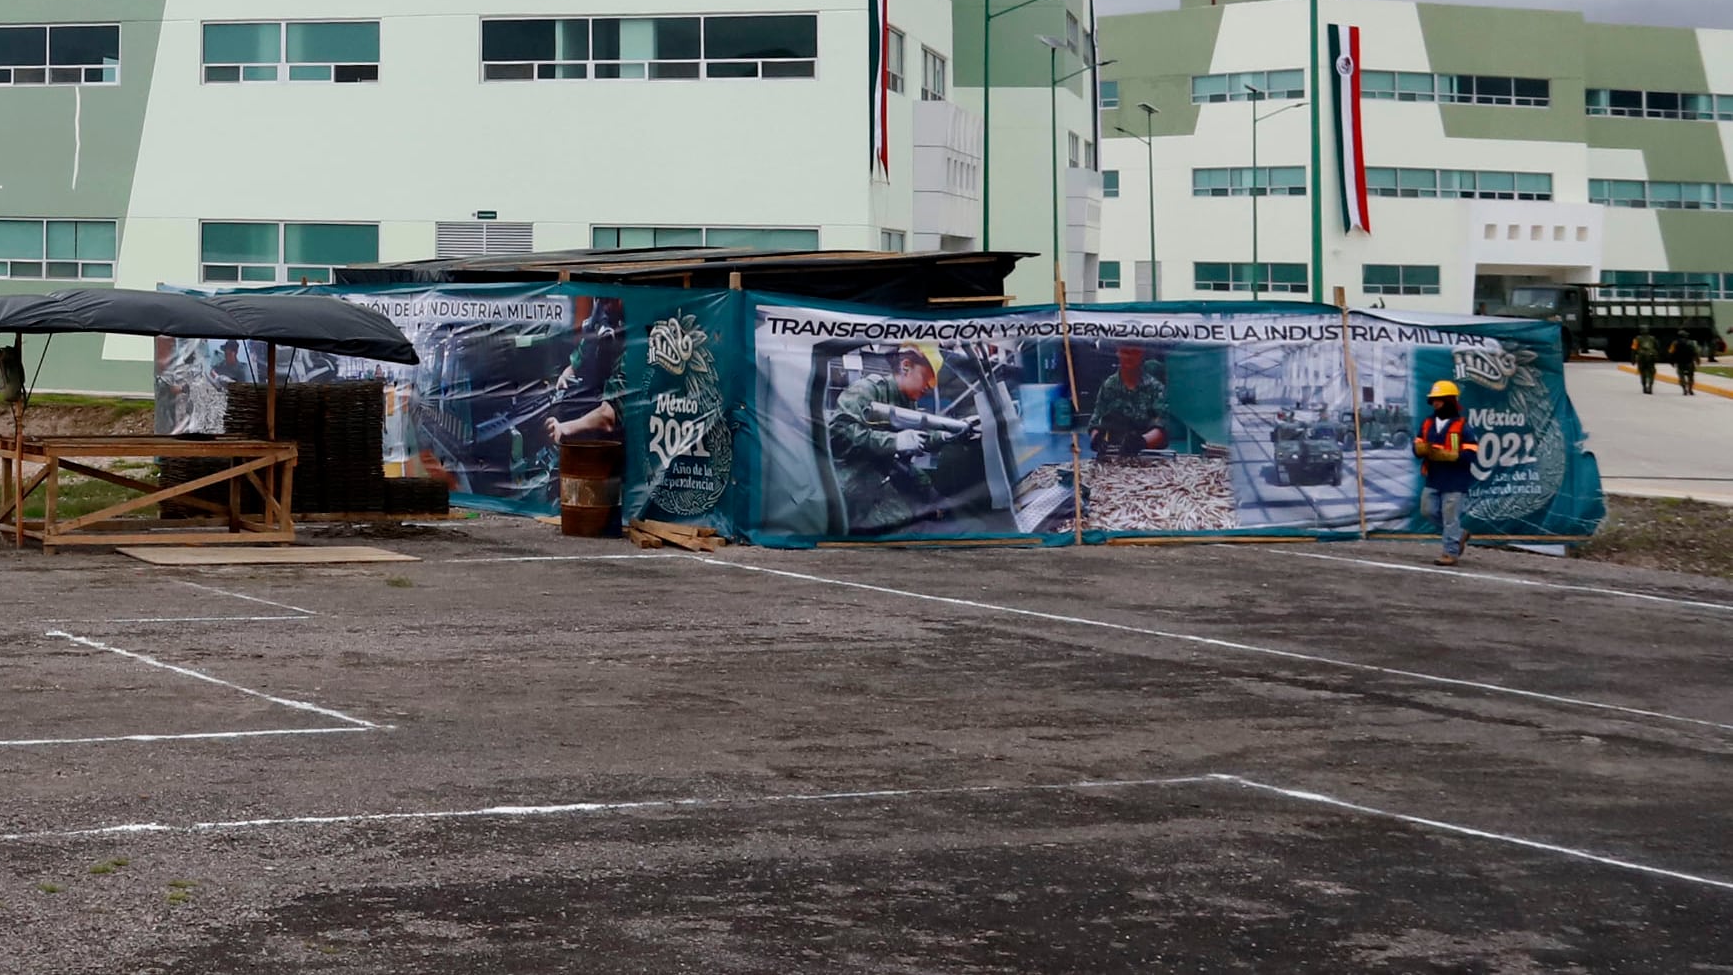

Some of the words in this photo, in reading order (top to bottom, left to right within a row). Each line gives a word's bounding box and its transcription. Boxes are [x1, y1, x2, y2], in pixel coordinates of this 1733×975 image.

[394, 302, 409, 316] DE
[412, 300, 425, 316] LA
[427, 302, 503, 318] INDUSTRIA
[508, 303, 564, 320] MILITAR
[767, 317, 995, 340] TRANSFORMACIÓN
[997, 323, 1016, 338] Y
[1016, 321, 1190, 339] MODERNIZACIÓN
[1193, 324, 1227, 341] DE
[1231, 325, 1259, 341] LA
[1265, 325, 1393, 342] INDUSTRIA
[1398, 327, 1485, 346] MILITAR
[655, 393, 698, 417] México
[1468, 408, 1525, 430] México
[650, 416, 710, 468] 2021
[1470, 432, 1538, 481] 021
[672, 462, 692, 475] Año
[693, 463, 703, 475] de
[704, 464, 713, 477] la
[1528, 469, 1540, 480] la
